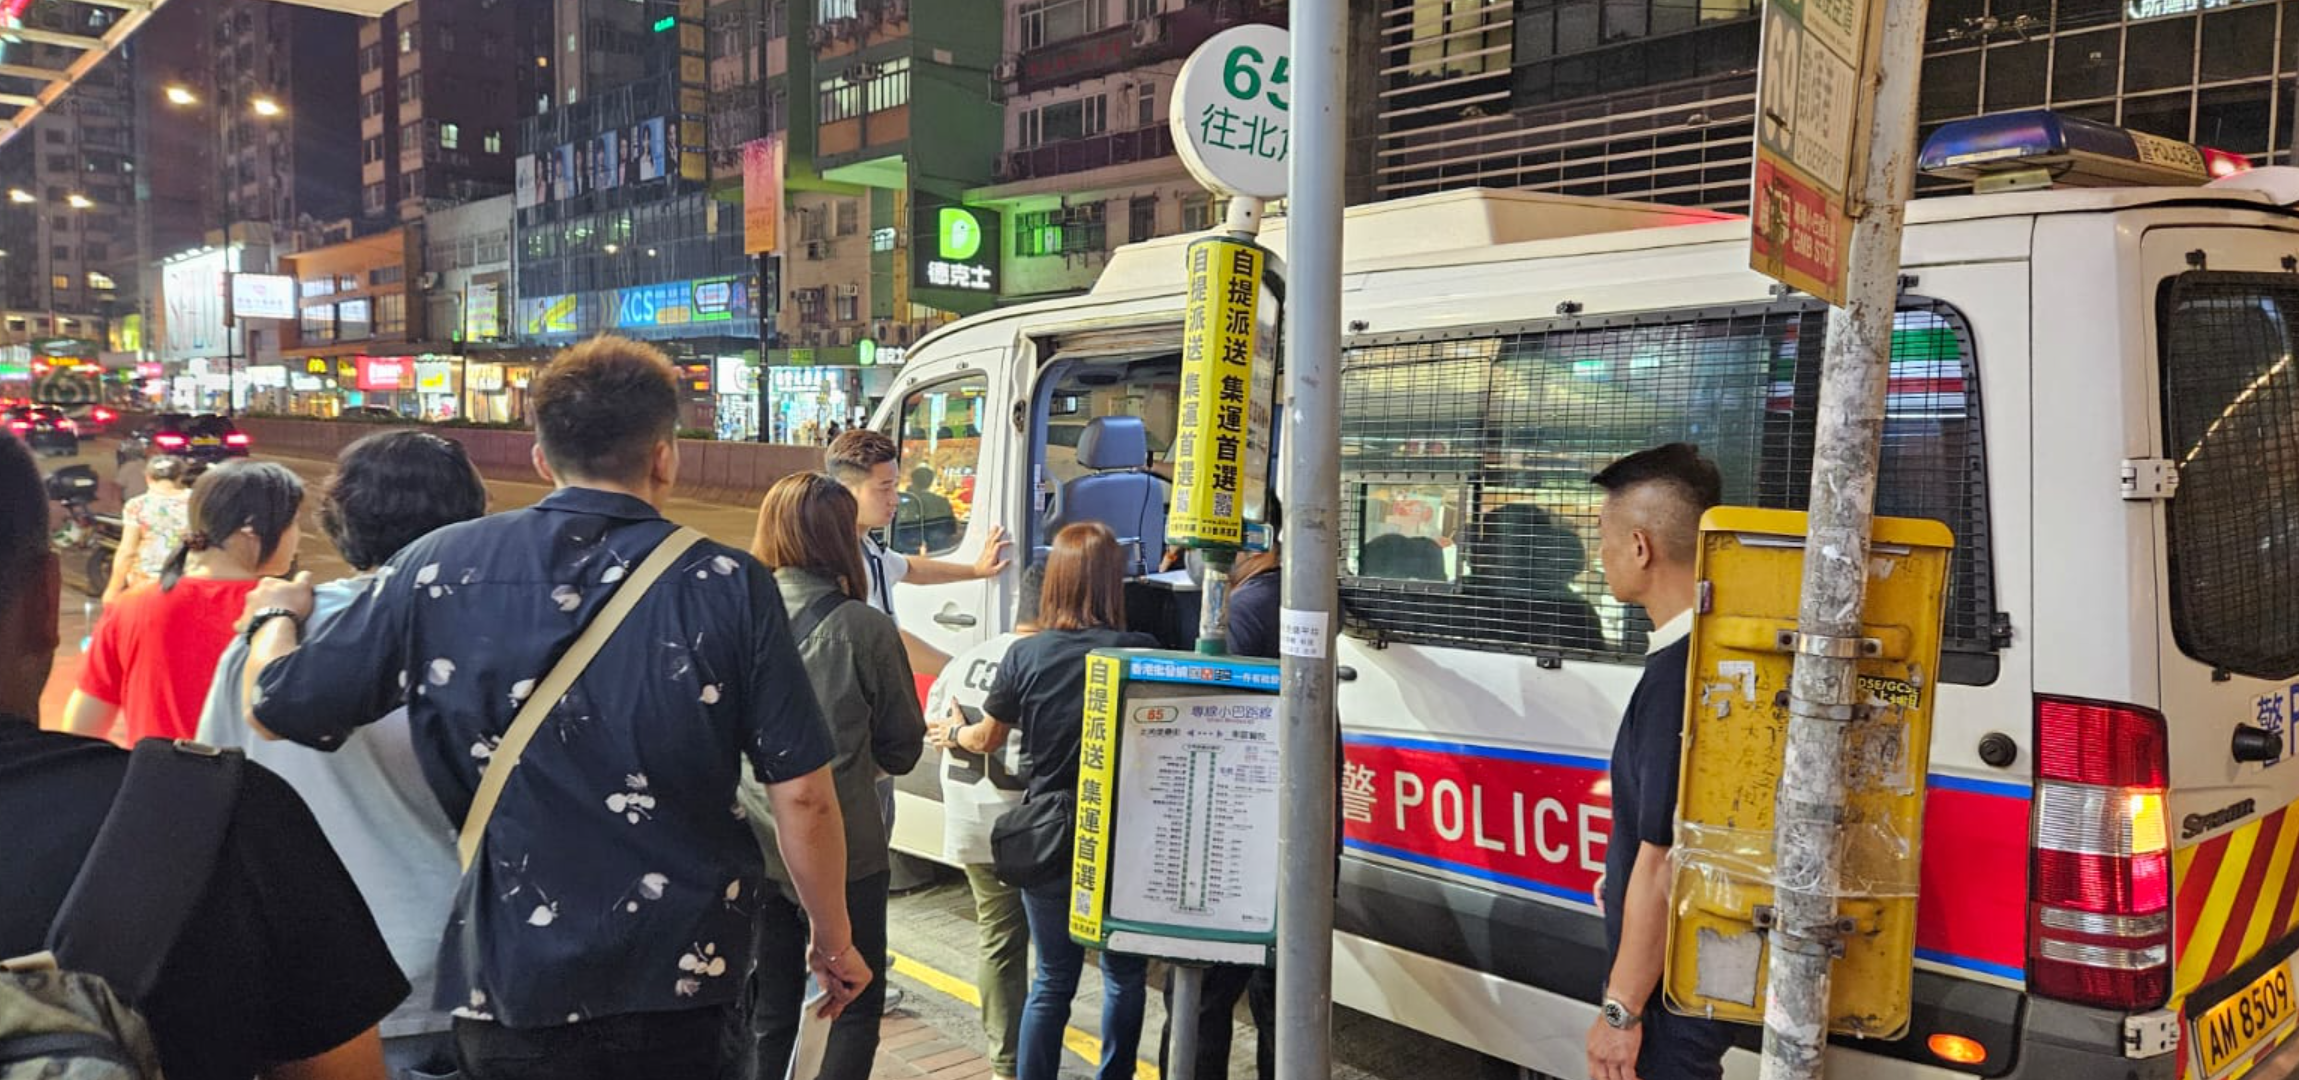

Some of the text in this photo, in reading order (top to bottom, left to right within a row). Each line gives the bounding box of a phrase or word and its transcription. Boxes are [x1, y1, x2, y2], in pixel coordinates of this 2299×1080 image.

[2151, 140, 2191, 165] POLICE
[927, 260, 993, 290] 德克士
[1792, 229, 1836, 268] GMB STOP
[620, 290, 655, 323] KCS
[1222, 250, 1254, 366] 自提派送
[1177, 247, 1208, 488] 自提派送 集運首選
[1212, 375, 1245, 492] 集運首選
[1084, 660, 1109, 770] 自提派送
[1075, 779, 1101, 891] 集運首選
[1342, 760, 1612, 874] 警 POLICE
[2209, 970, 2288, 1066] AM 8509
